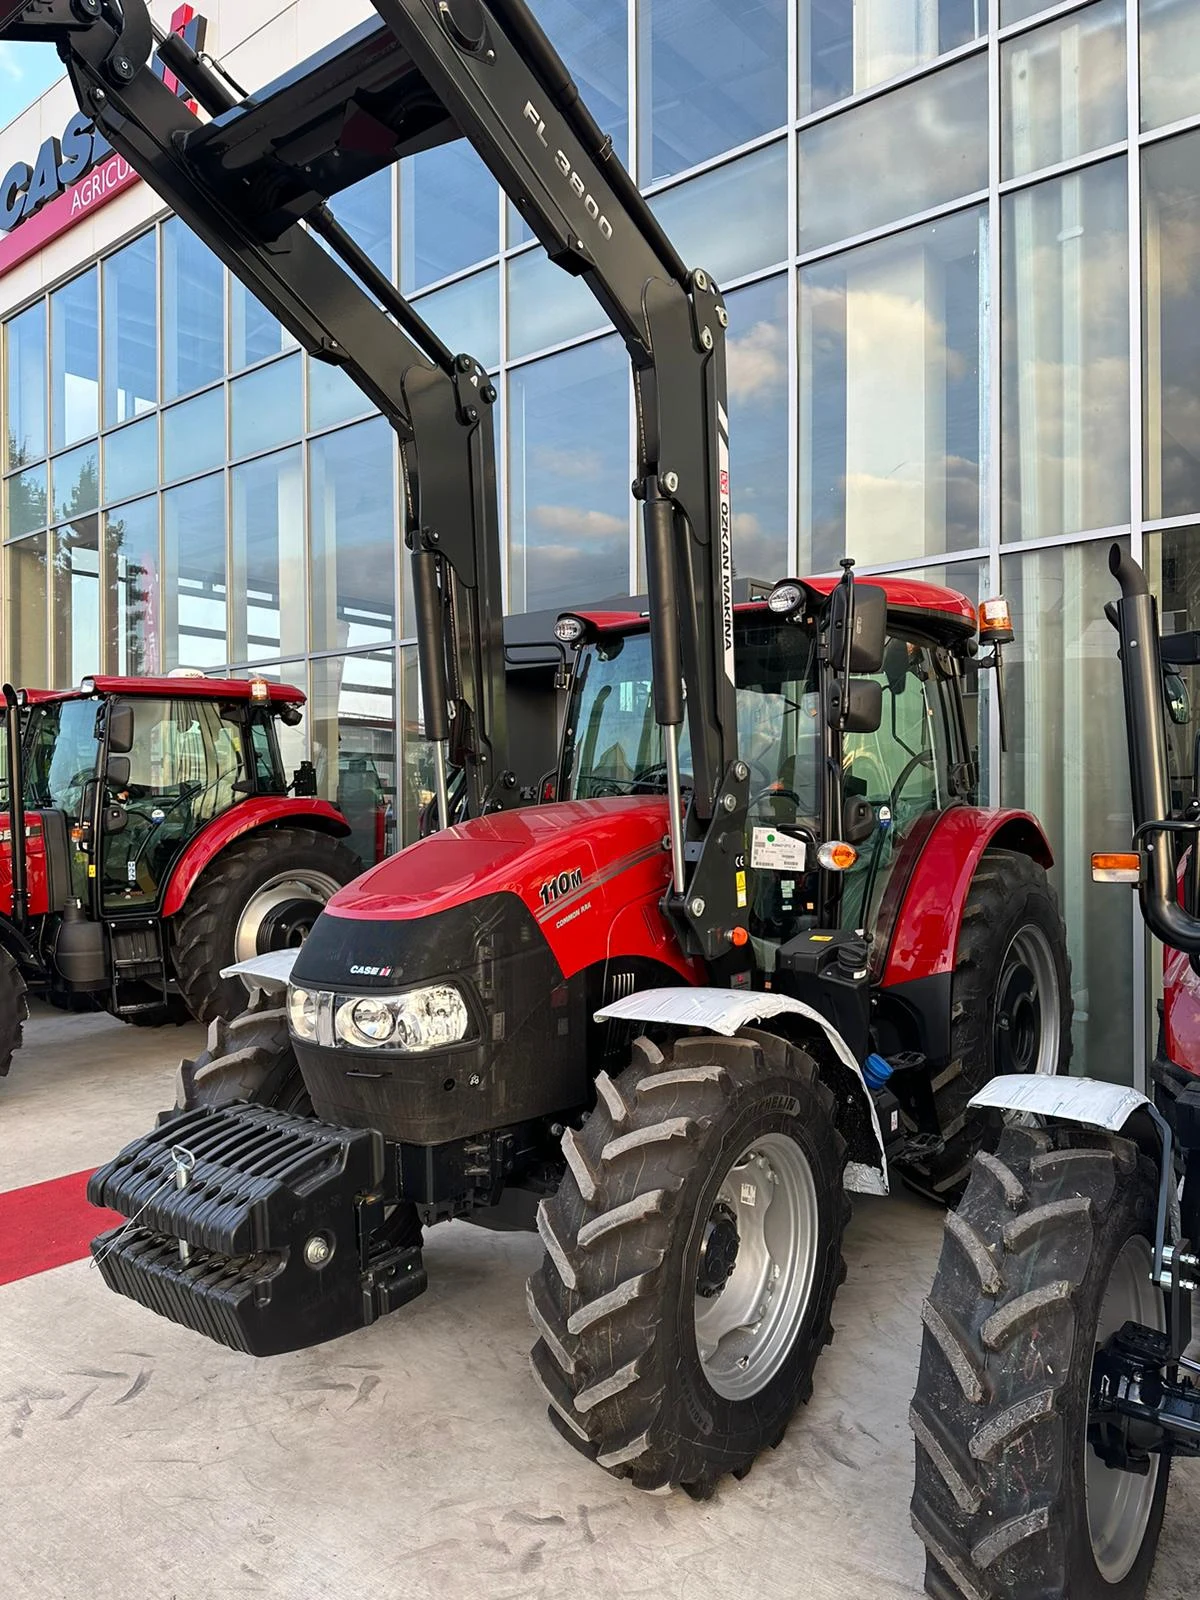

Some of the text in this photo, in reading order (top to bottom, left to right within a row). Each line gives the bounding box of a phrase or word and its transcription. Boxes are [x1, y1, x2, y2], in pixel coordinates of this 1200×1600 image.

[523, 100, 613, 241] FL 3800
[350, 965, 380, 976] CASE
